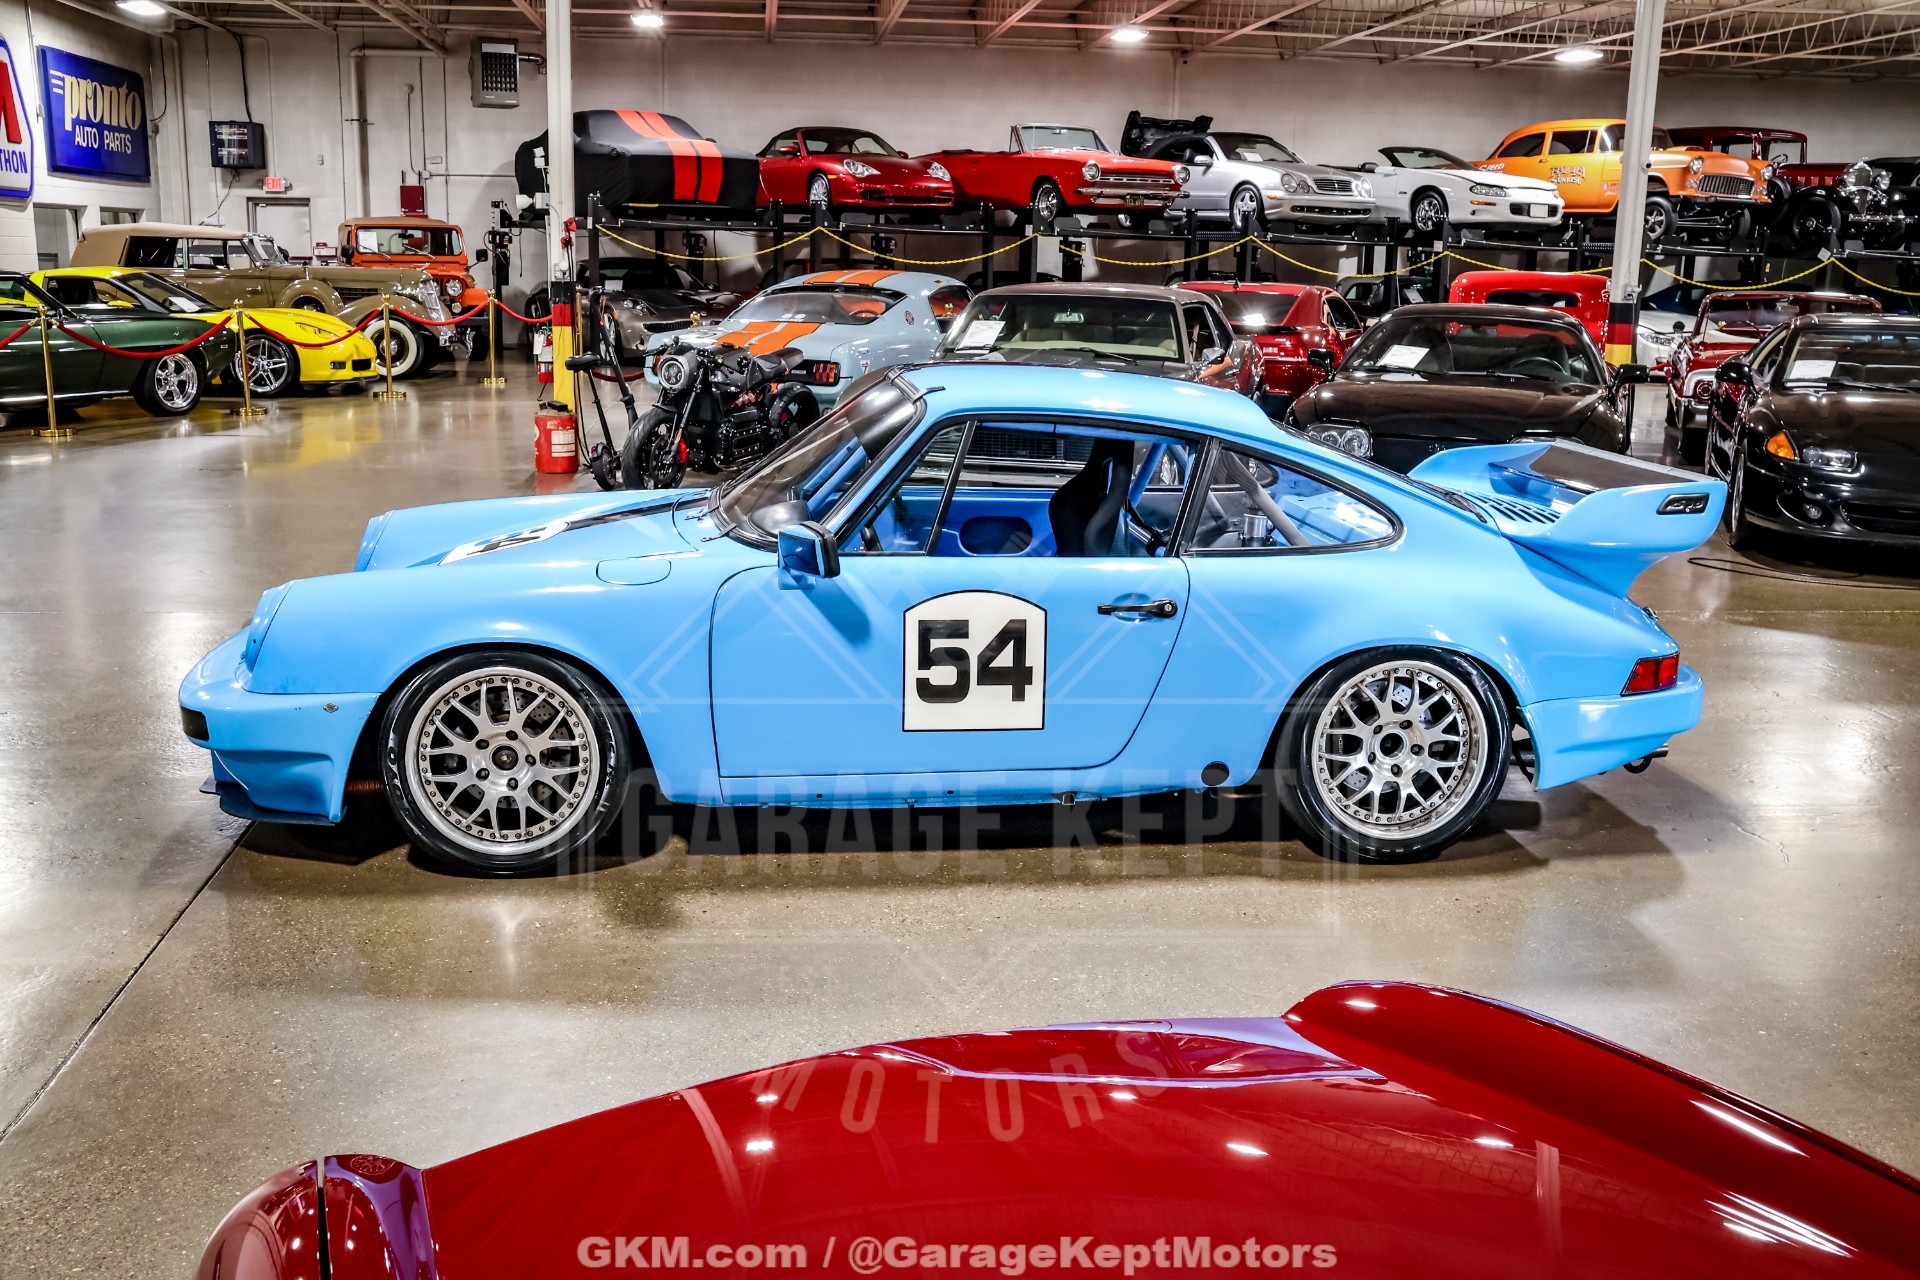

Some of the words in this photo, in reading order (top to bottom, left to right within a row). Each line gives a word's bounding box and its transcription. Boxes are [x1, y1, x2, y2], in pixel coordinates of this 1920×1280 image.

[62, 74, 142, 131] pronto
[75, 125, 99, 149] AUTO
[104, 130, 132, 154] PARTS
[266, 177, 282, 190] EXIT
[916, 619, 1034, 704] 54
